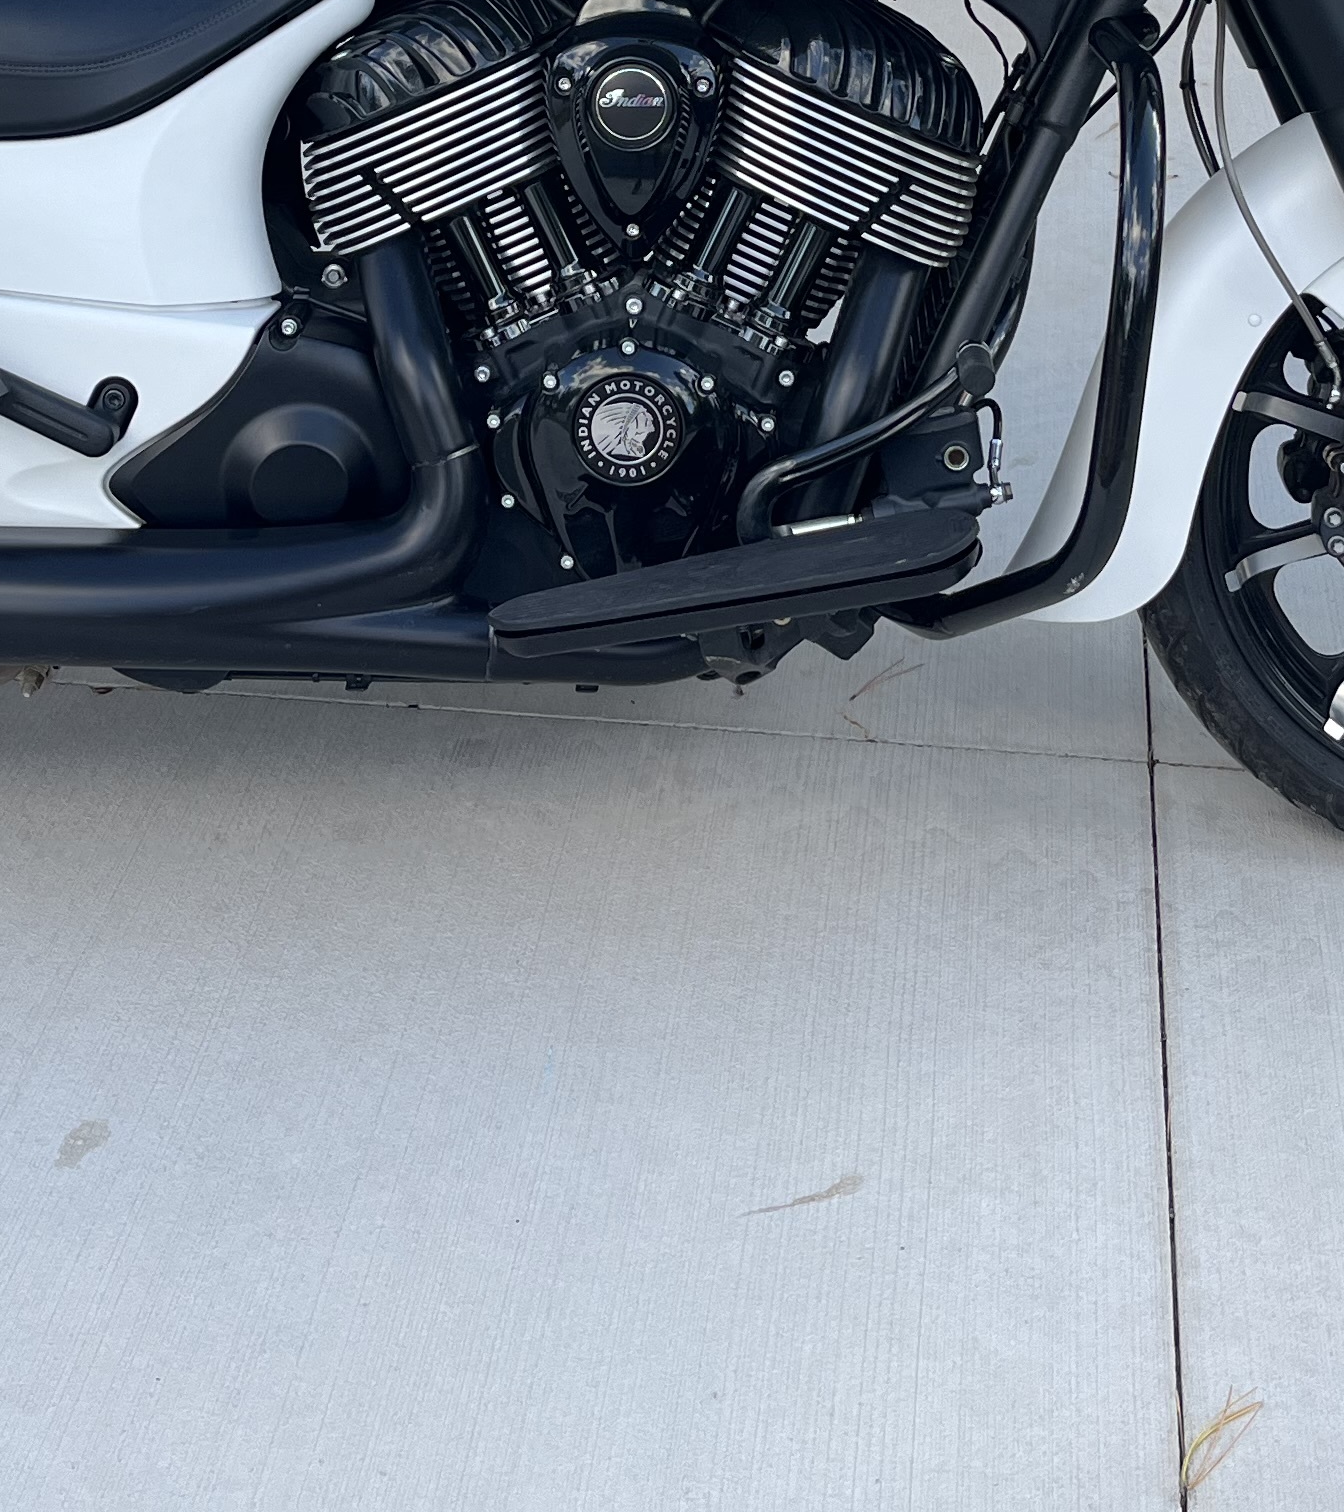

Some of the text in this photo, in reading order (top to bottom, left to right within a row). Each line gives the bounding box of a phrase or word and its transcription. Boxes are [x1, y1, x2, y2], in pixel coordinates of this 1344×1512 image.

[599, 88, 664, 108] Indian
[578, 380, 677, 460] INDIAN MOTORCYCLE
[609, 465, 646, 478] 1901
